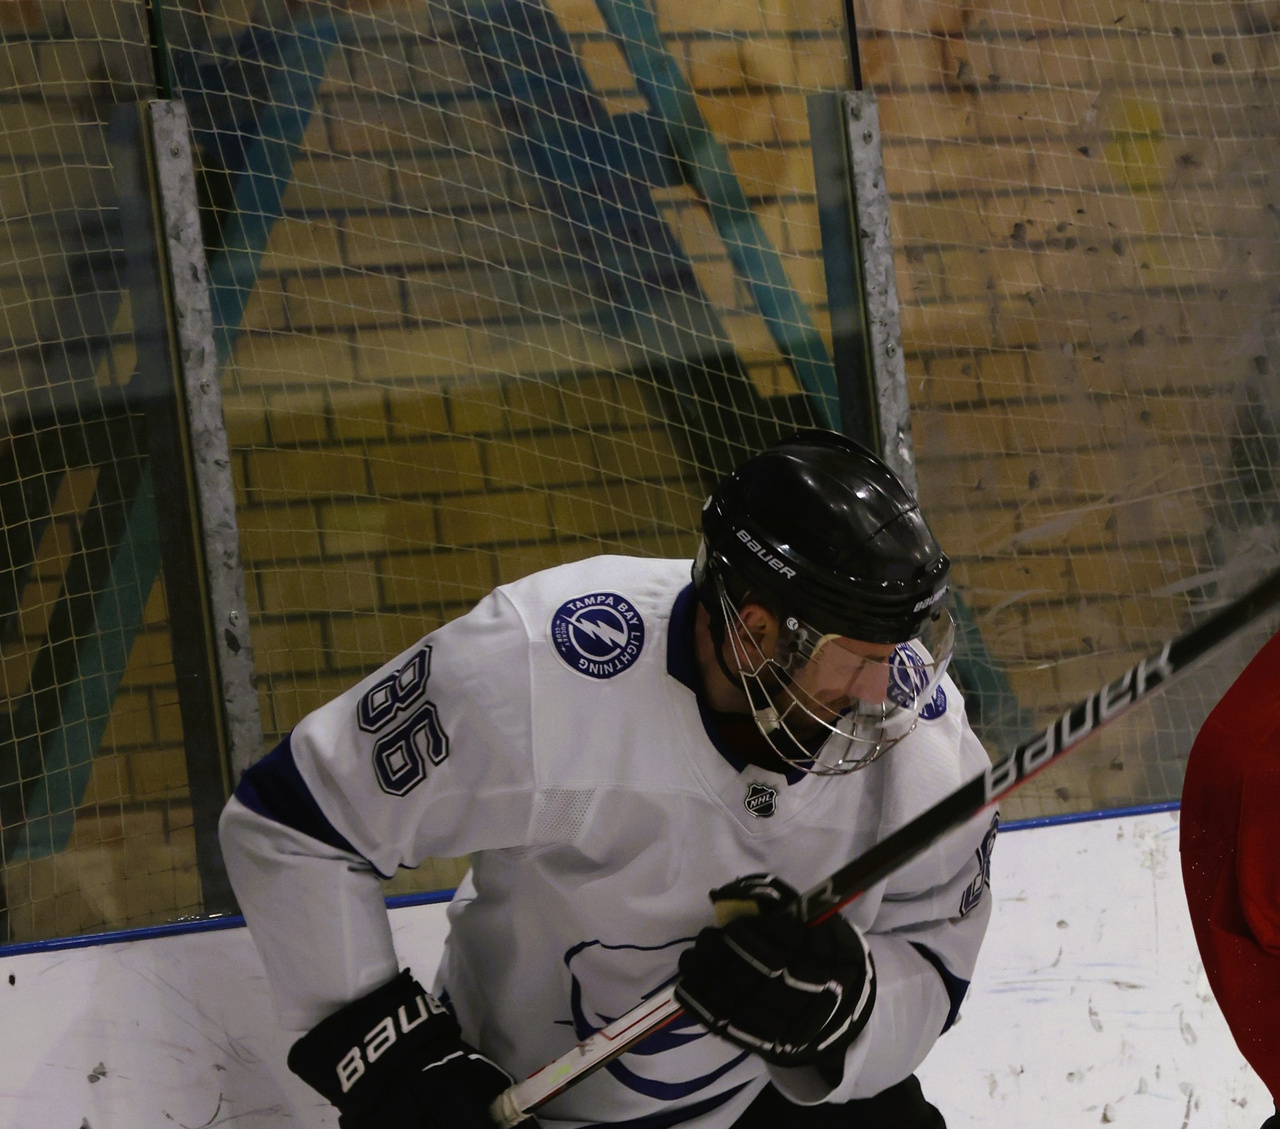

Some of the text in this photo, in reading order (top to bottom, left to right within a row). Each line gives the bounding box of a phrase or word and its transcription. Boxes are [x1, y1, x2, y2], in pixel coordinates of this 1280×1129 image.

[736, 530, 797, 579] BAUER
[566, 595, 641, 675] TAMPA BAY LIGHTNING
[357, 644, 449, 797] 86
[750, 794, 772, 809] NHL
